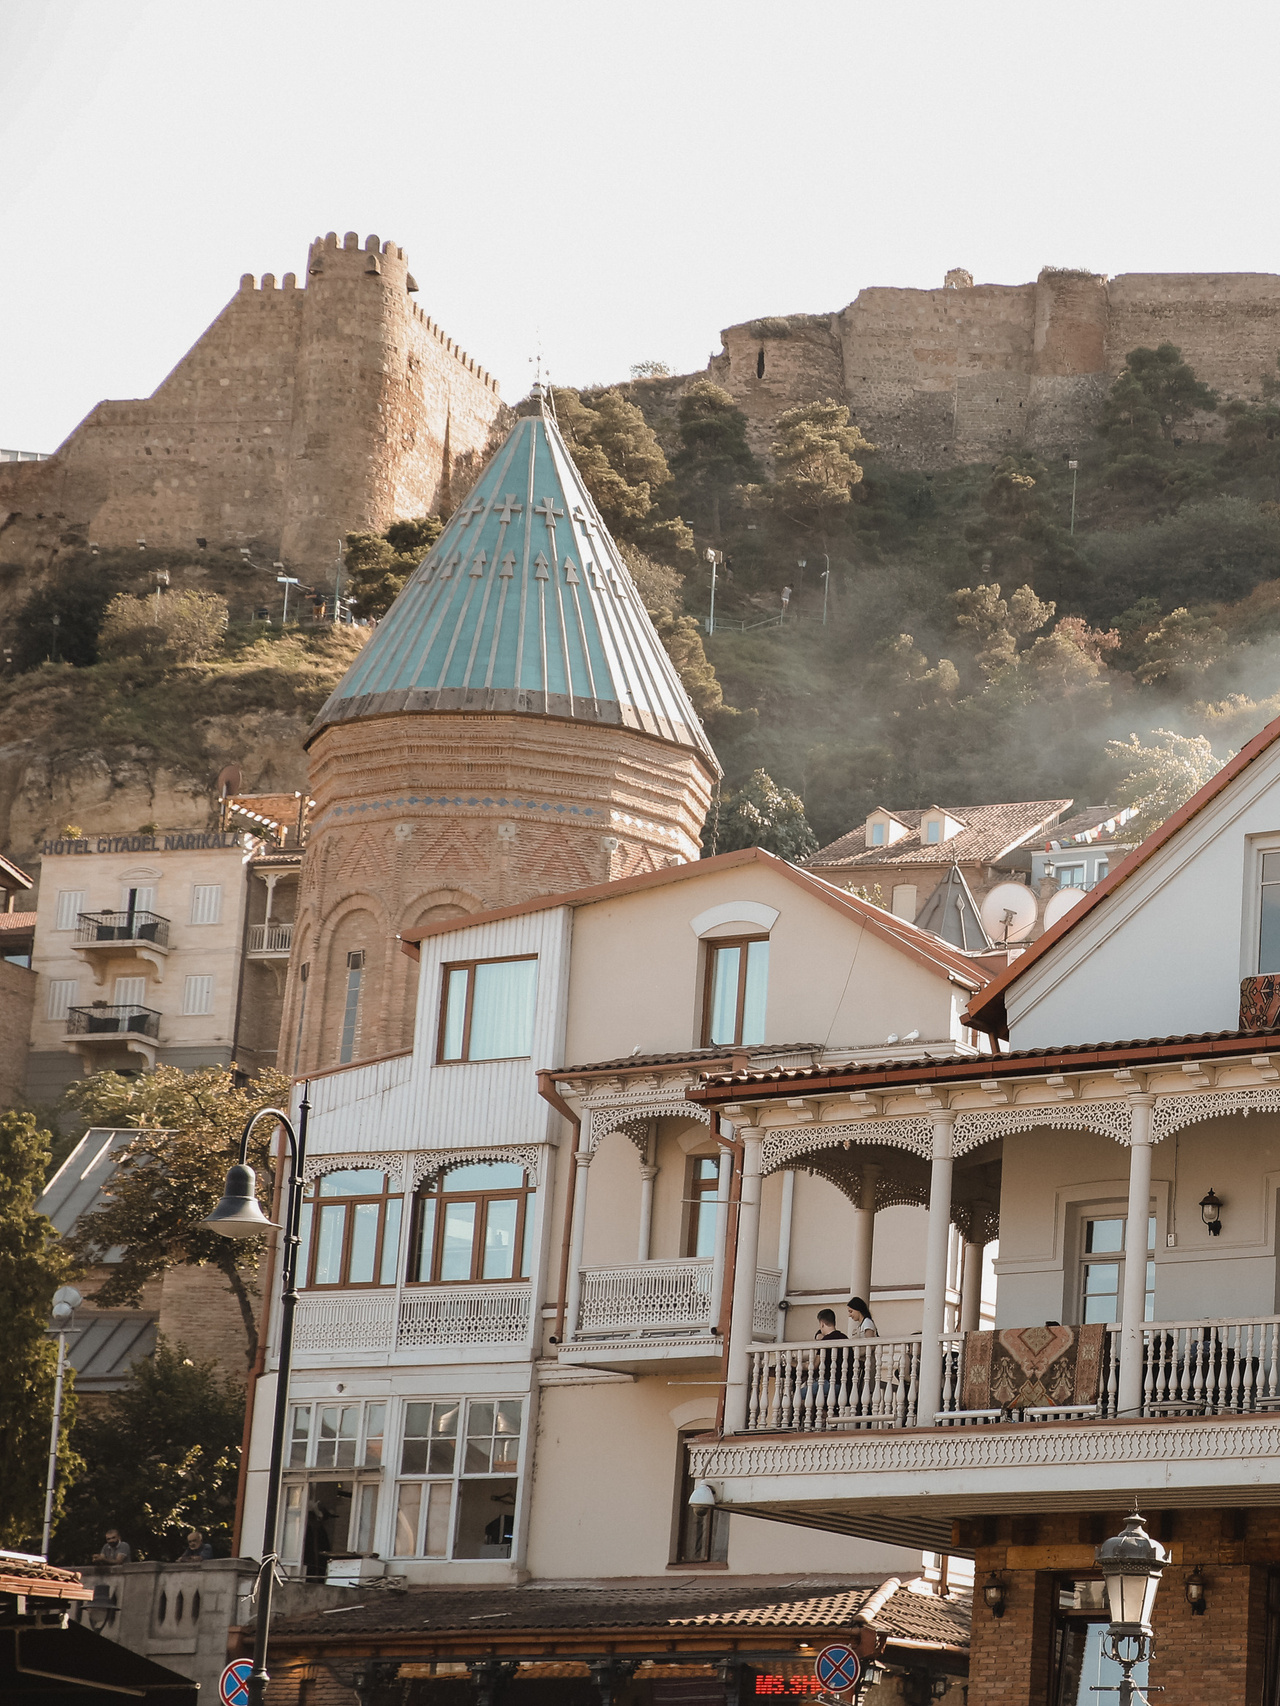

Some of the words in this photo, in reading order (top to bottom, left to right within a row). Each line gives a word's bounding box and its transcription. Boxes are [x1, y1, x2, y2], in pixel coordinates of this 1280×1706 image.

[43, 839, 92, 855] HOTEL
[97, 836, 159, 853] CITADEL
[164, 834, 239, 851] NARIKALA
